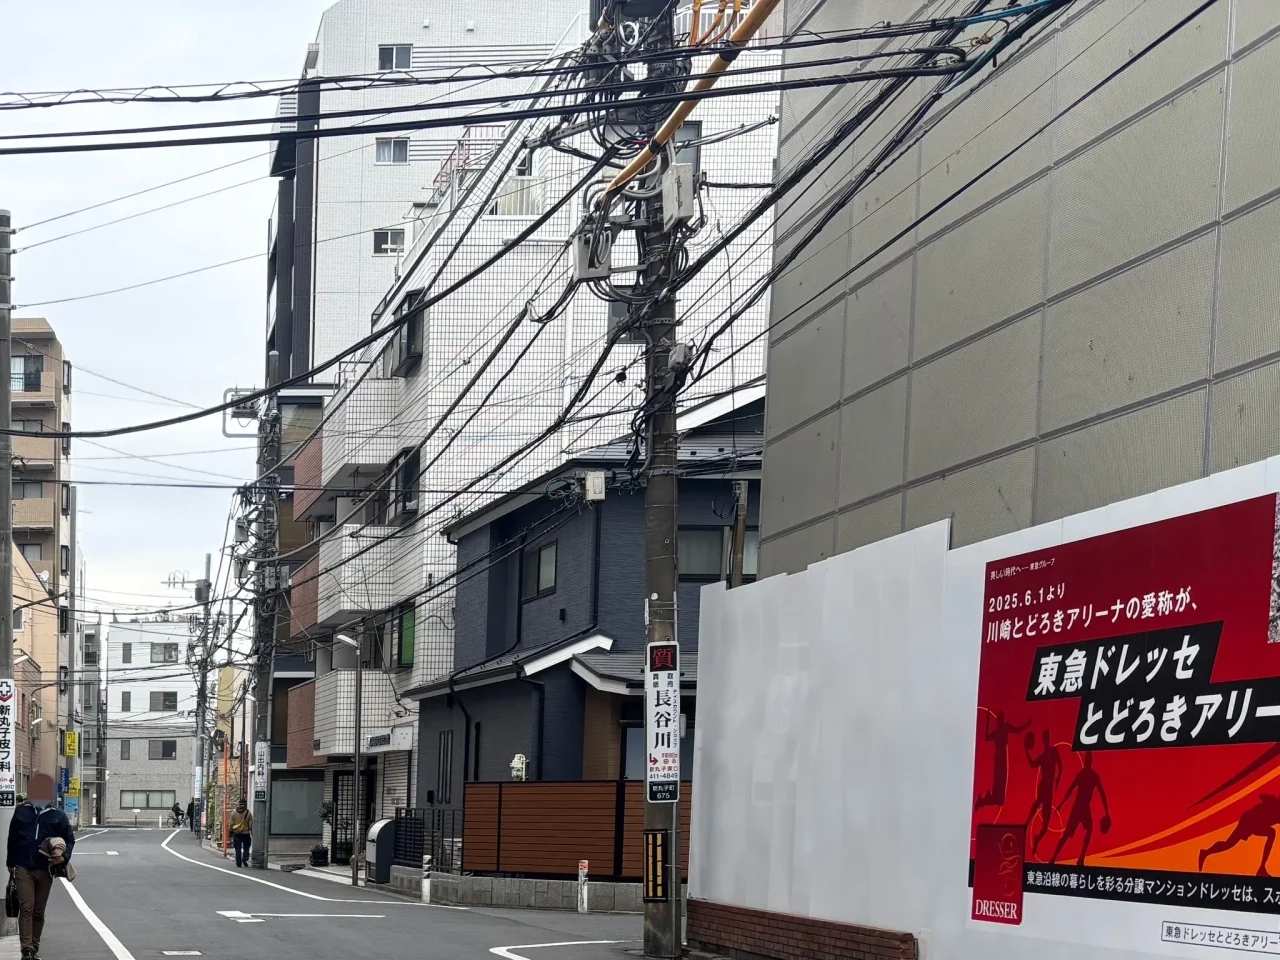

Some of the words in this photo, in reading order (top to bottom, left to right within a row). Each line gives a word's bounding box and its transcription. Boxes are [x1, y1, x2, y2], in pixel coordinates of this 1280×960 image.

[988, 583, 1065, 613] 2025.6.1より
[986, 586, 1198, 643] 川崎とどろきアリーナの愛称が、
[653, 649, 674, 669] 質
[1034, 635, 1200, 696] 東急ドレッセ
[654, 690, 672, 749] 長谷川
[975, 899, 1018, 920] DRESSER
[1165, 925, 1280, 949] 東急ドレッセとどろきアリー
